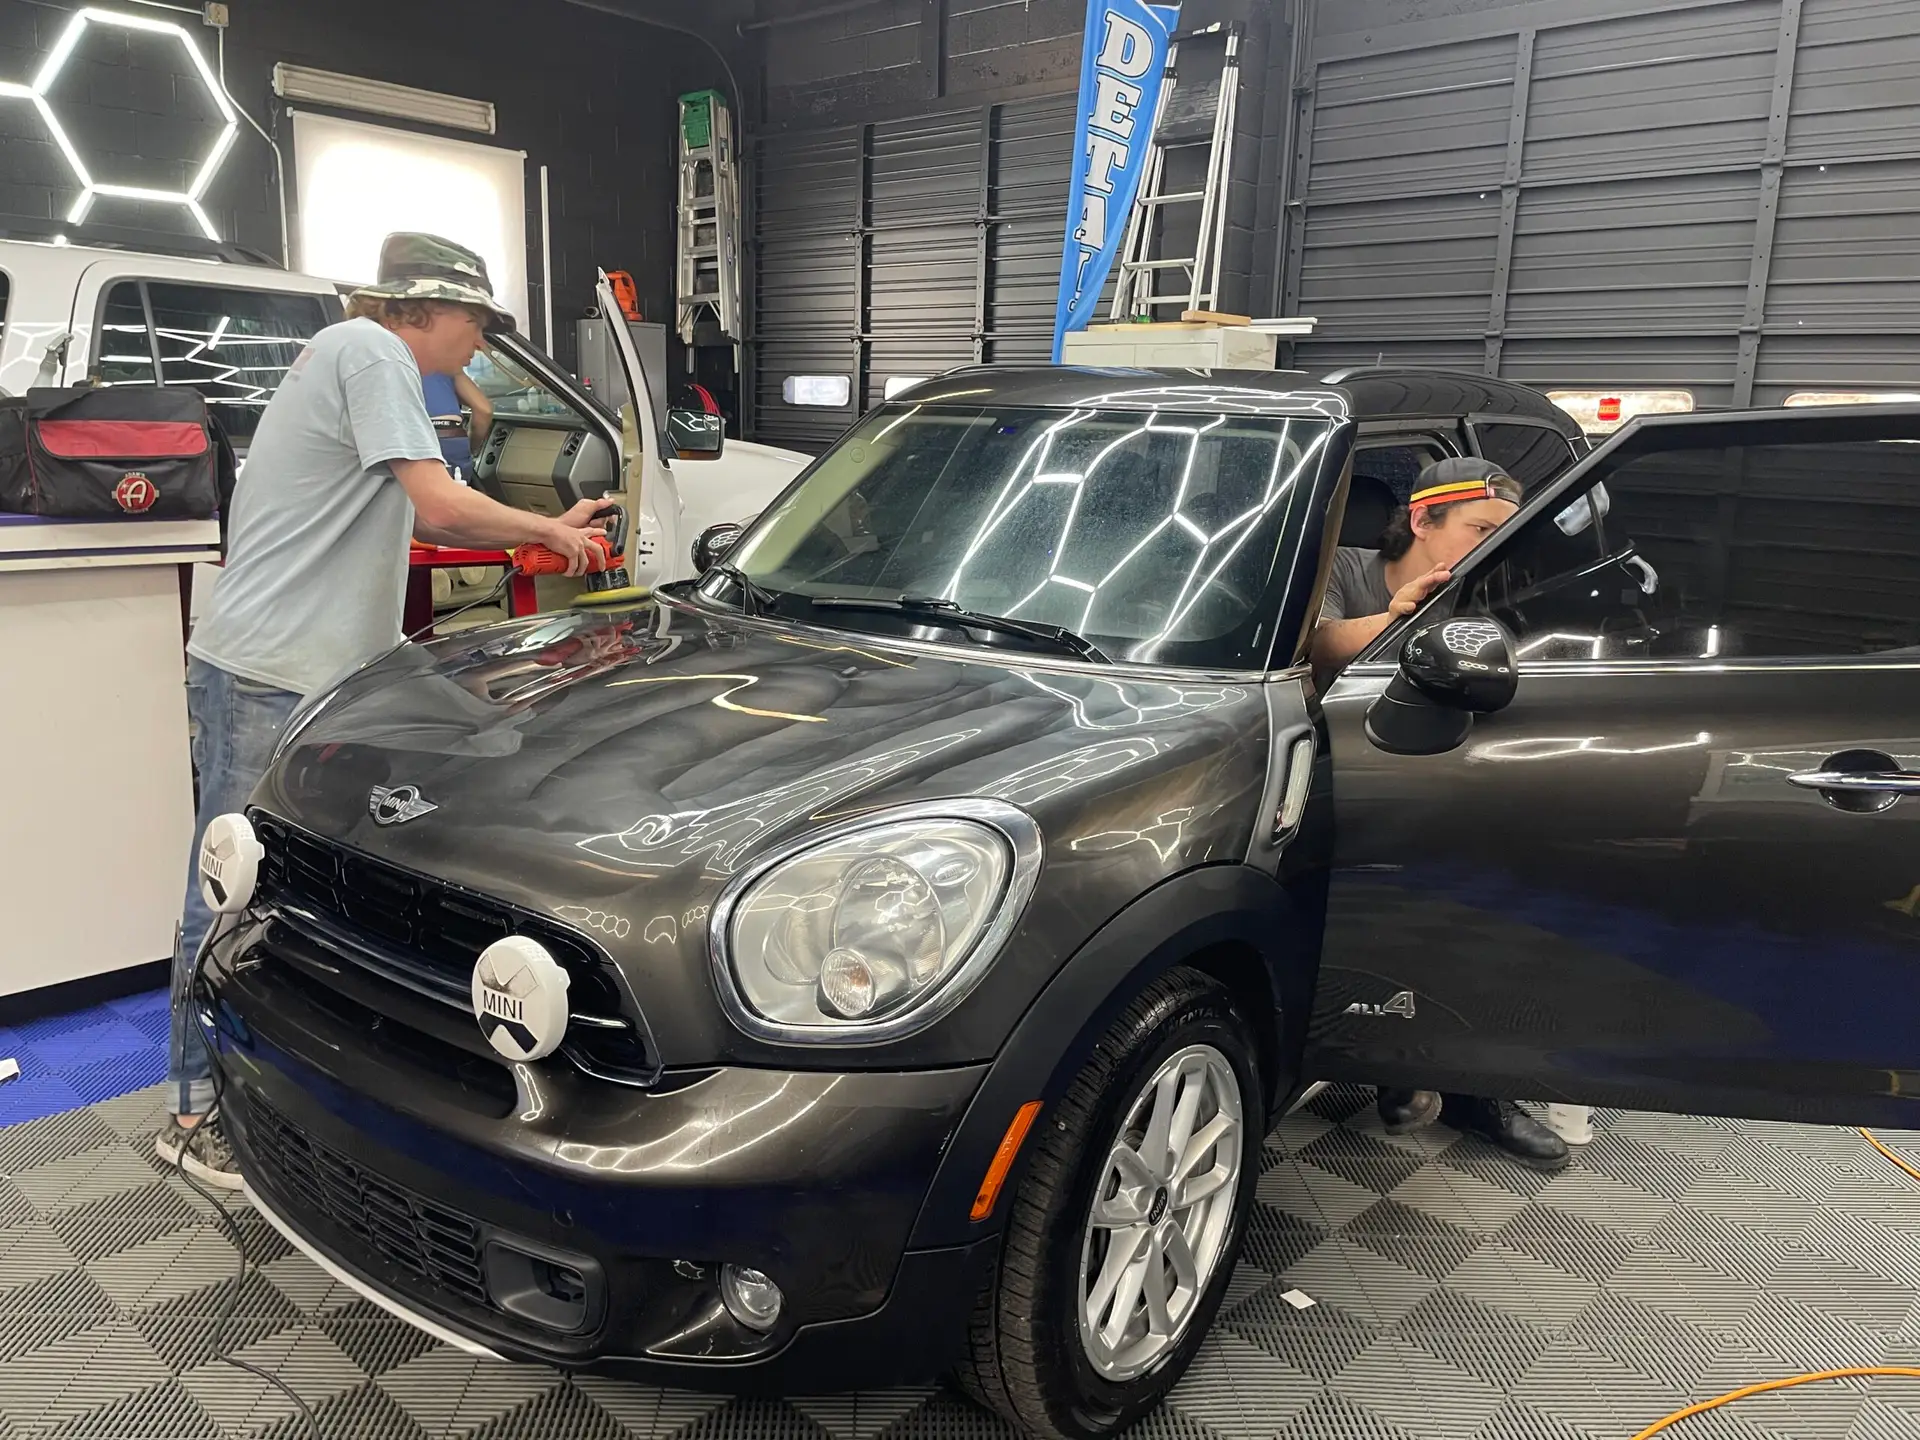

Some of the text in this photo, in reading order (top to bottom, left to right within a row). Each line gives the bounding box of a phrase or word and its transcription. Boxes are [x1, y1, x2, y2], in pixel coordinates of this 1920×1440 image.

[382, 795, 408, 811] MINI
[201, 851, 223, 879] MINI
[483, 988, 524, 1021] MINI
[1150, 1191, 1167, 1221] MINI
